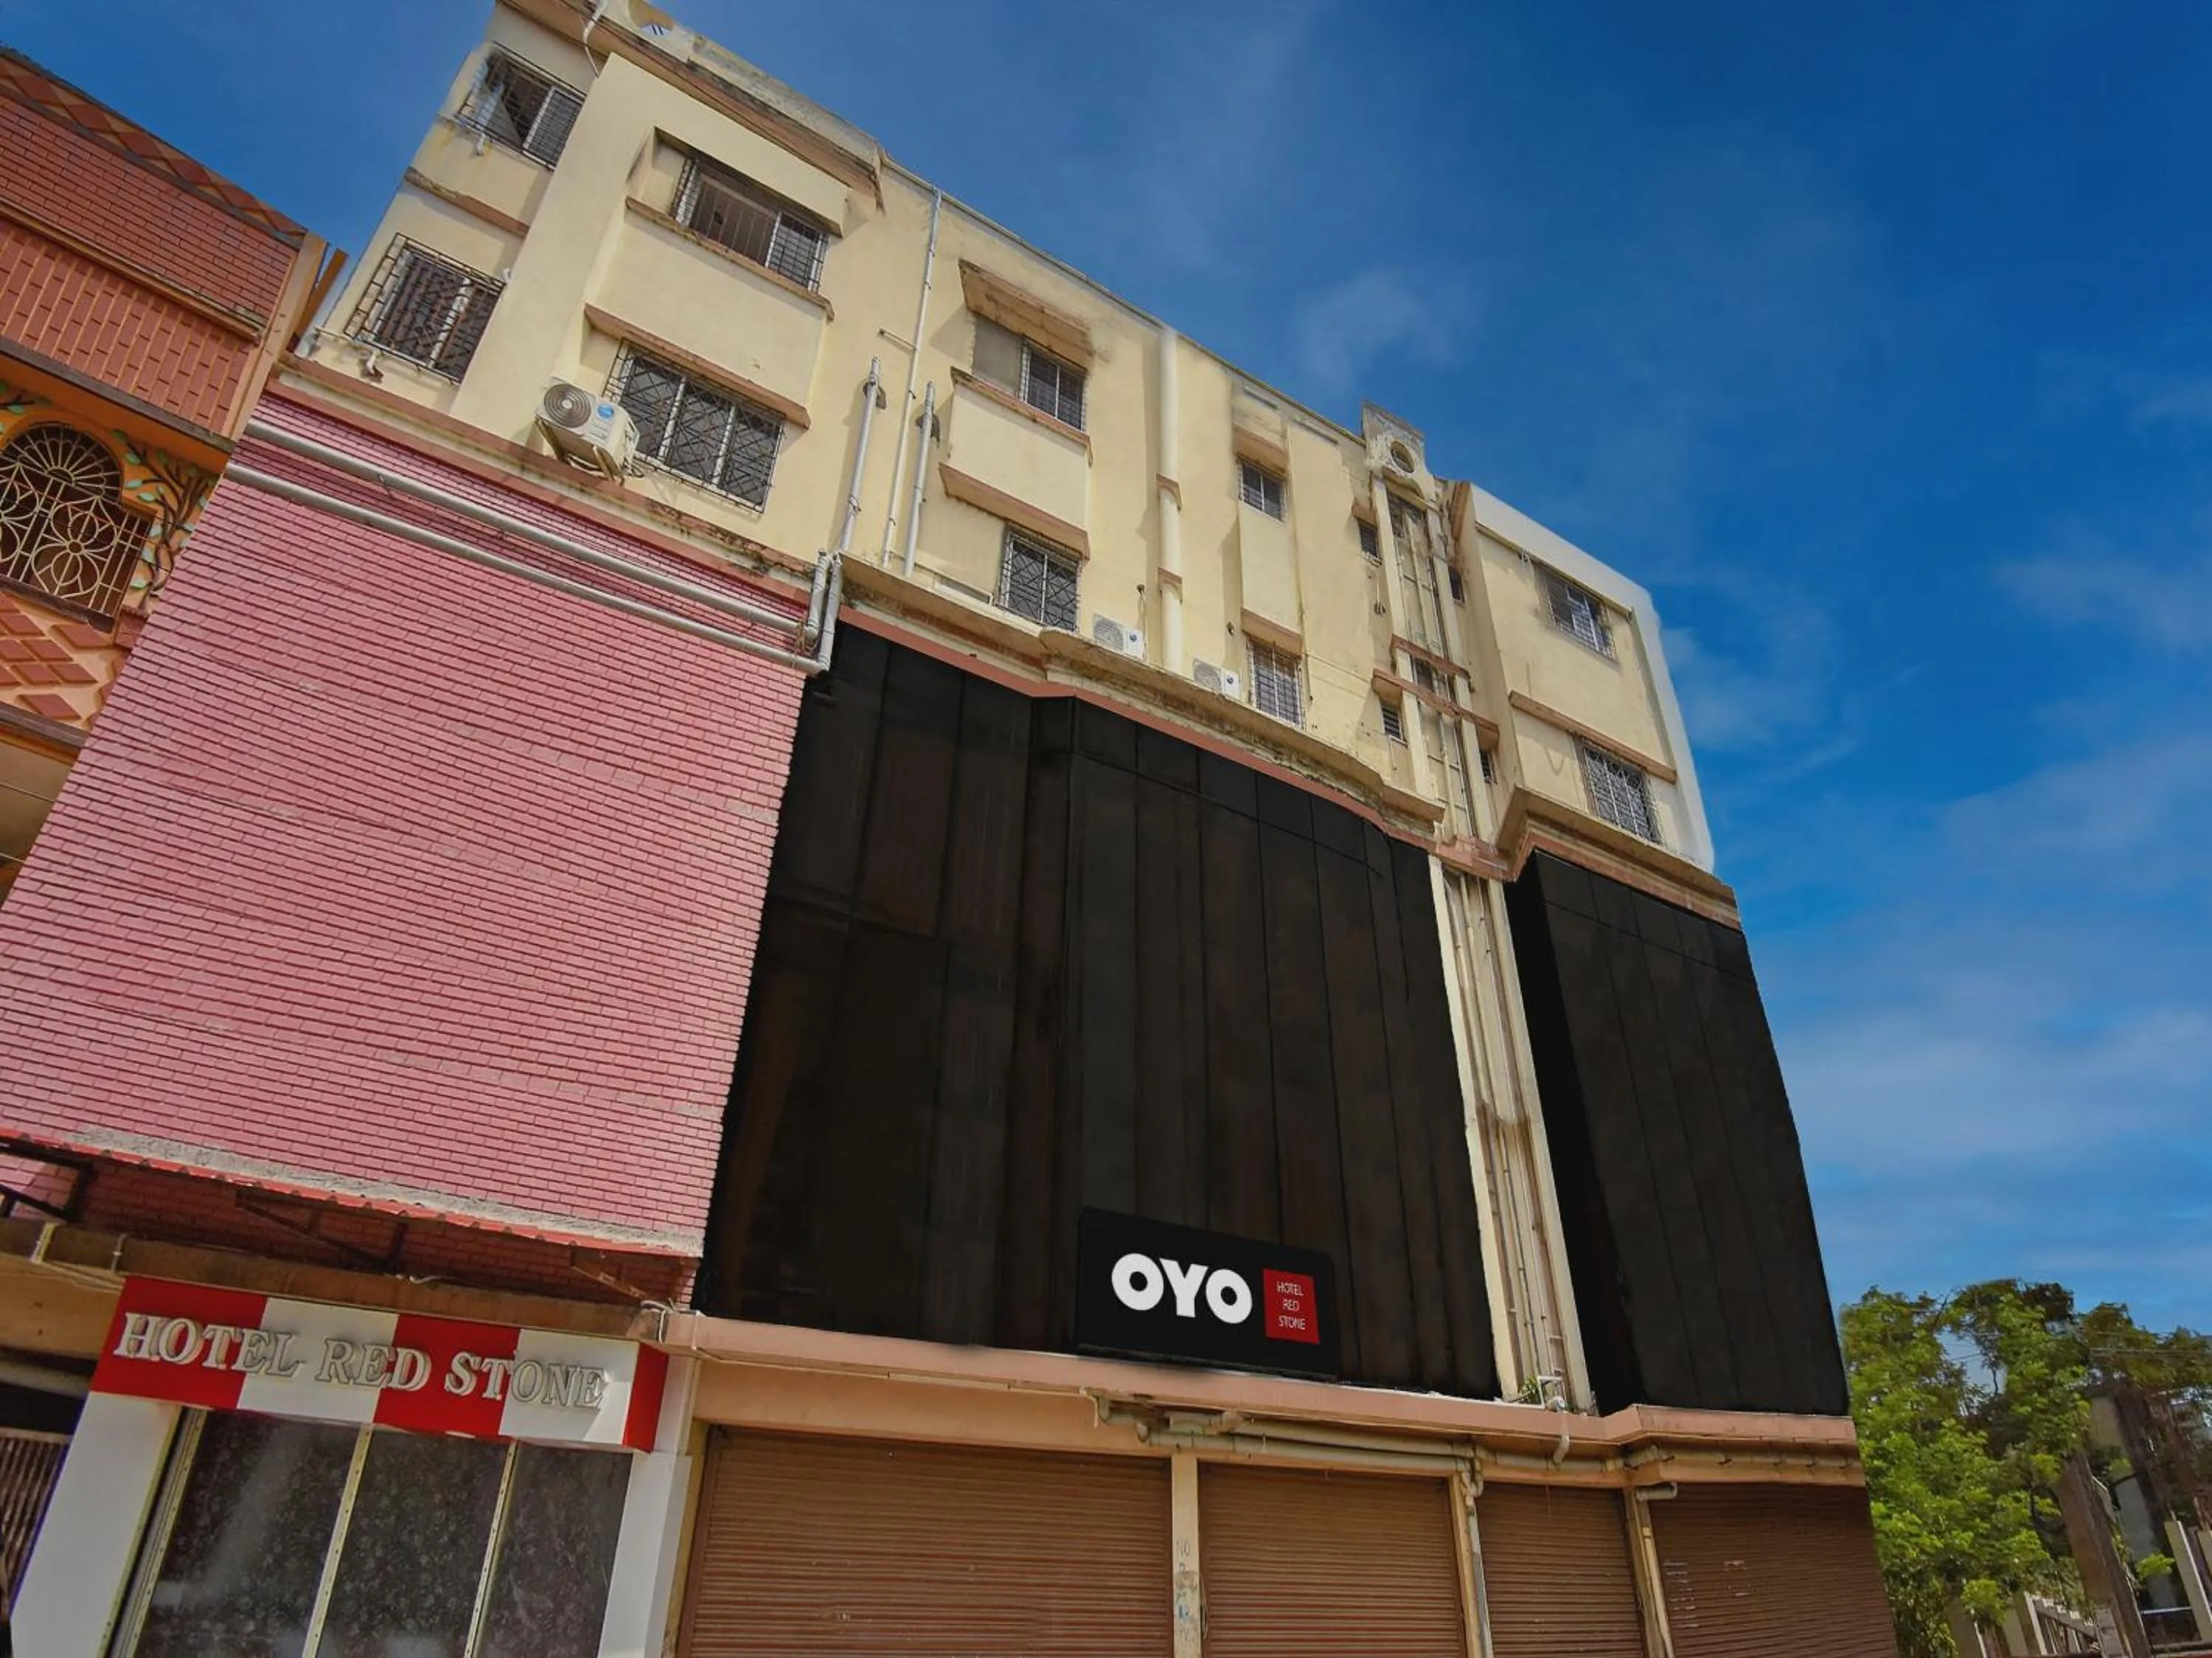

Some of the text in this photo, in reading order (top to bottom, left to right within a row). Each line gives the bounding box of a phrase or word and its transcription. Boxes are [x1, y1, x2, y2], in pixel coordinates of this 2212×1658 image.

[1111, 1253, 1253, 1324] OYO
[1276, 1280, 1304, 1296] HOTEL
[1282, 1299, 1300, 1311] RED
[1279, 1315, 1306, 1330] STONE
[113, 1311, 608, 1409] HOTEL RED STONE
